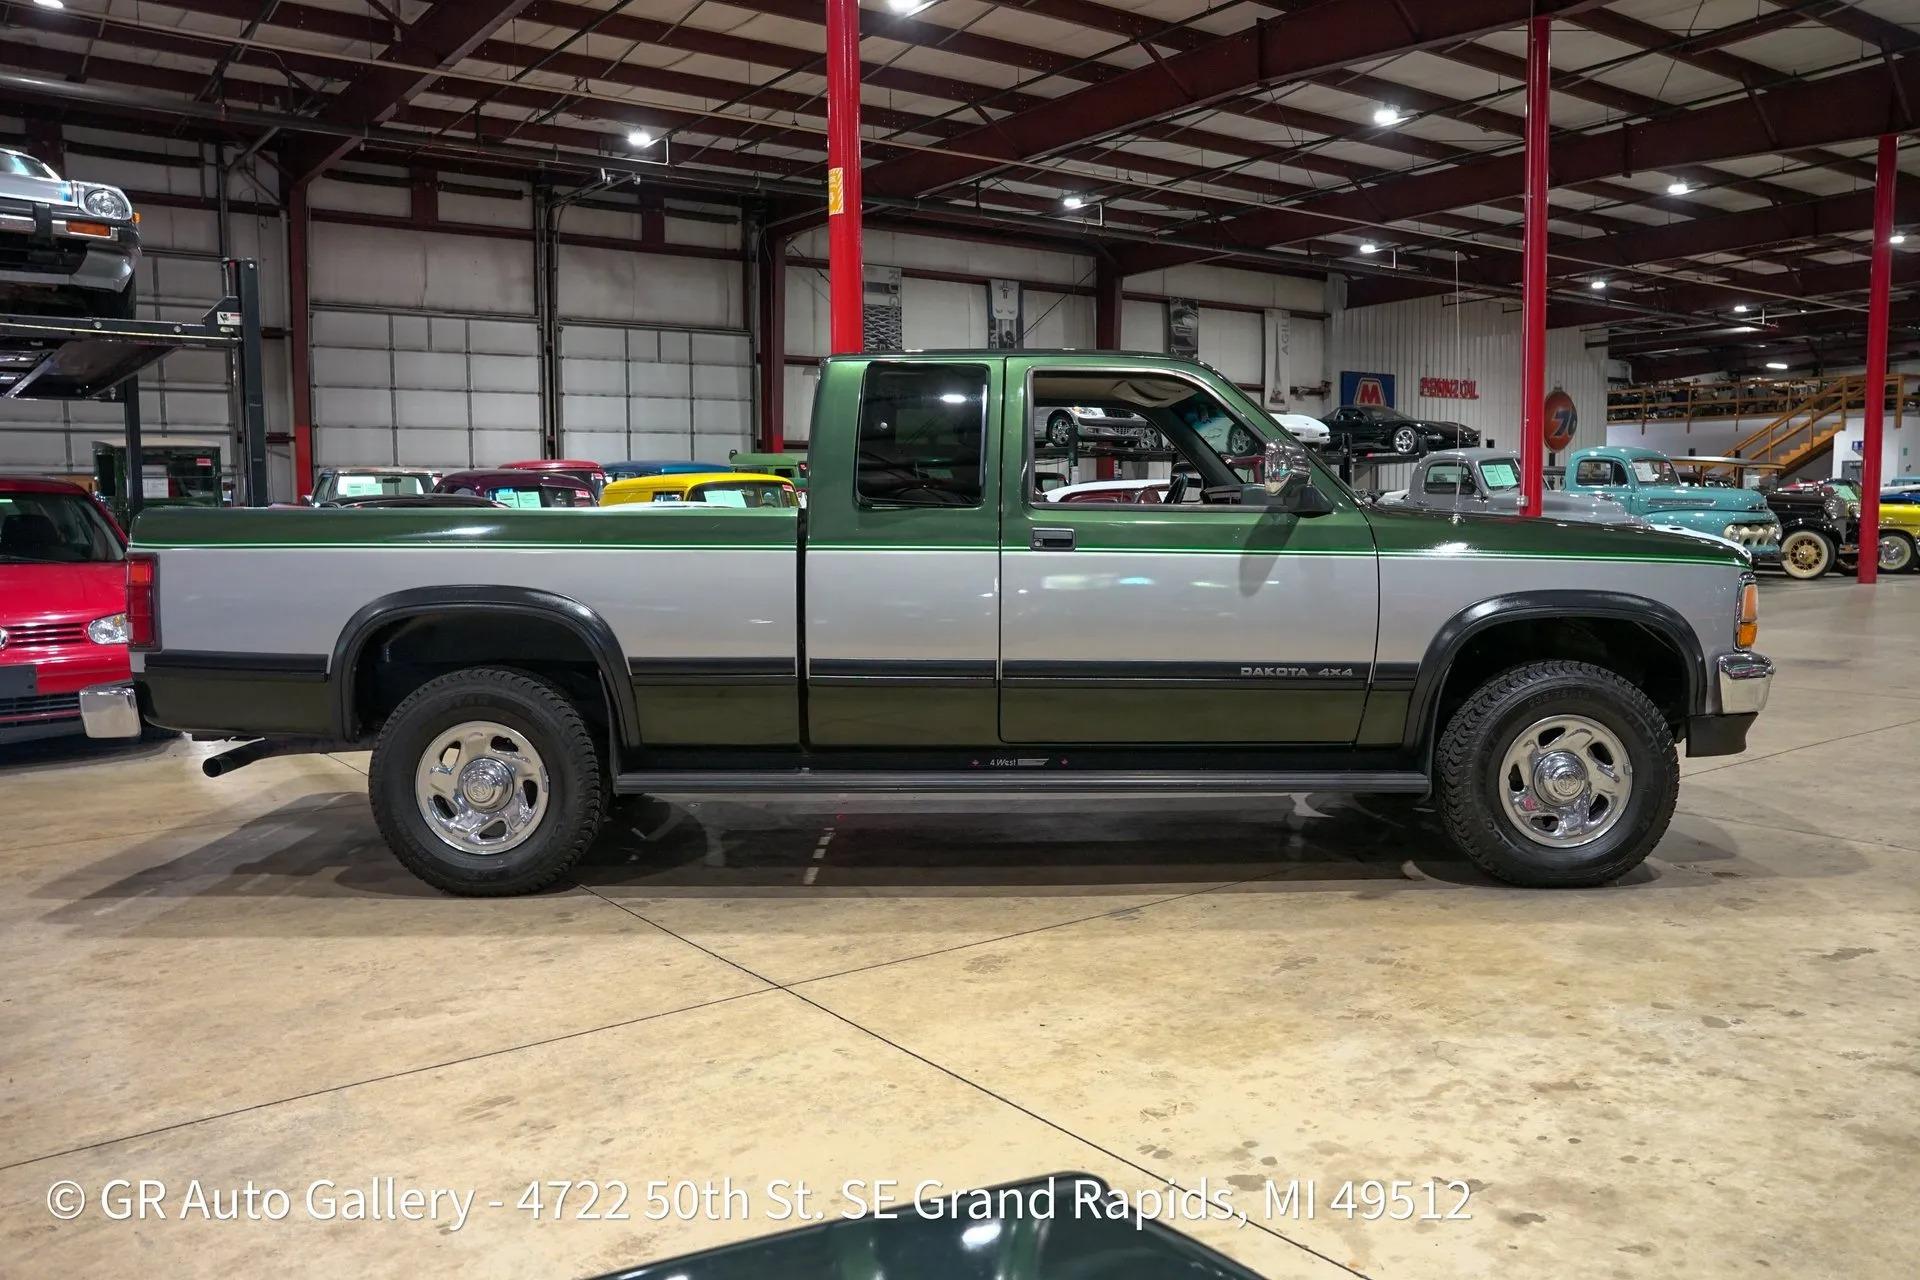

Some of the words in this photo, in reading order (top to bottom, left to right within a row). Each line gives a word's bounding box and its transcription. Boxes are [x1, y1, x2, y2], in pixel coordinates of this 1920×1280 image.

[1359, 383, 1381, 404] M
[1240, 667, 1309, 677] DAKOTA
[996, 758, 1016, 767] West
